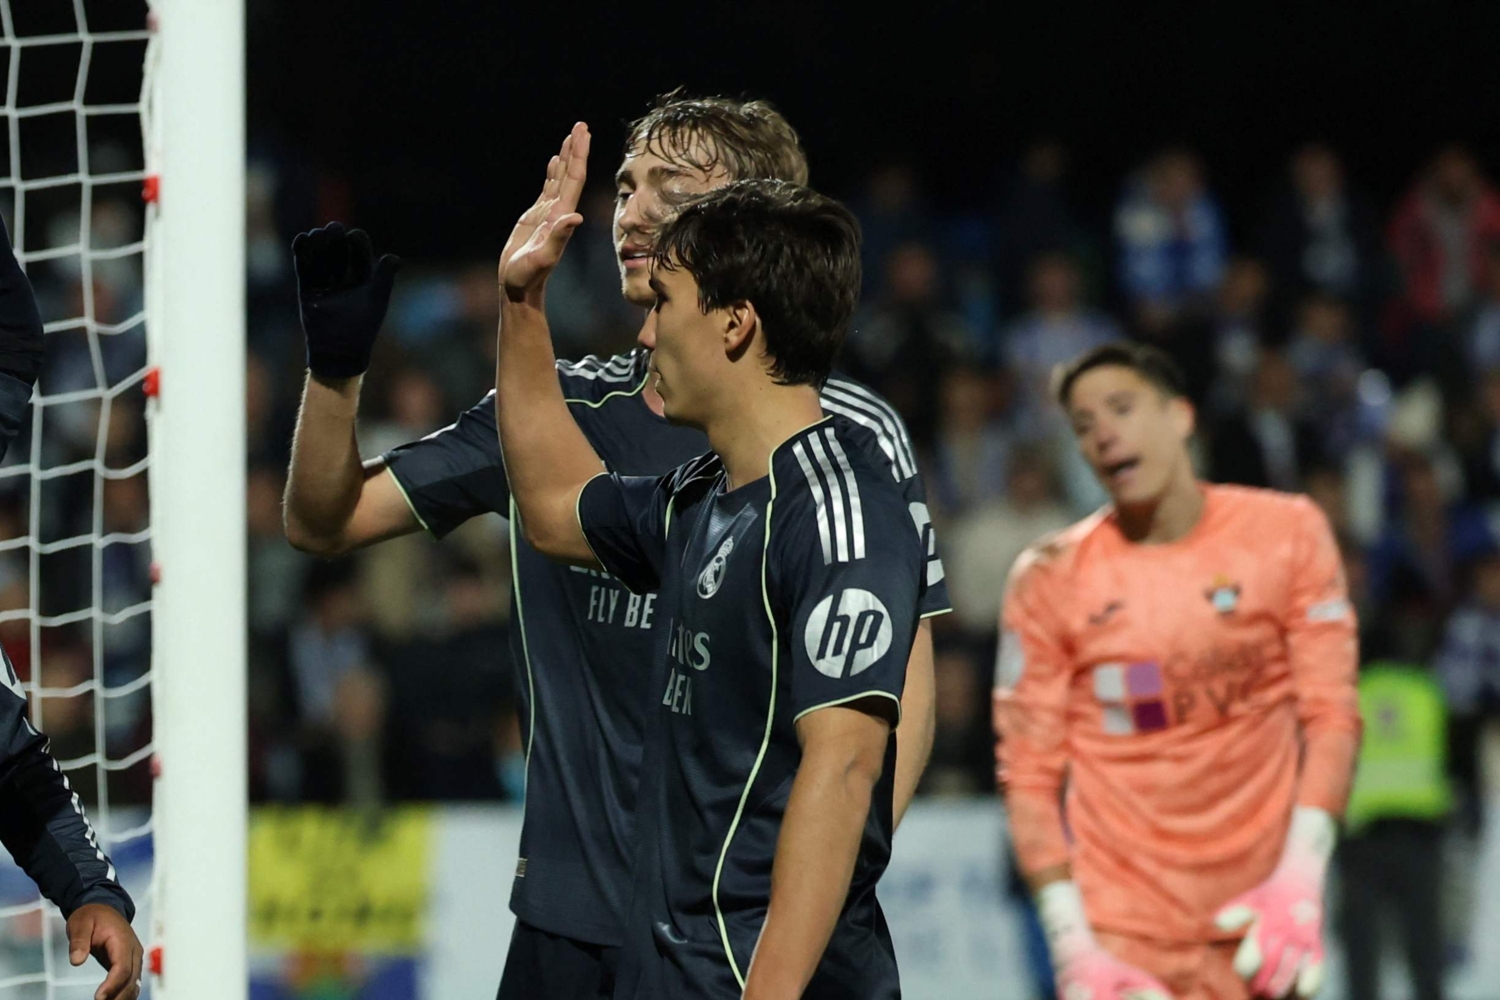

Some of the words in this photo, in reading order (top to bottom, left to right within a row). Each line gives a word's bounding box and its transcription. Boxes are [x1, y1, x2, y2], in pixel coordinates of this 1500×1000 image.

[588, 585, 620, 624] FLY
[624, 592, 658, 629] BE
[812, 590, 887, 679] hp
